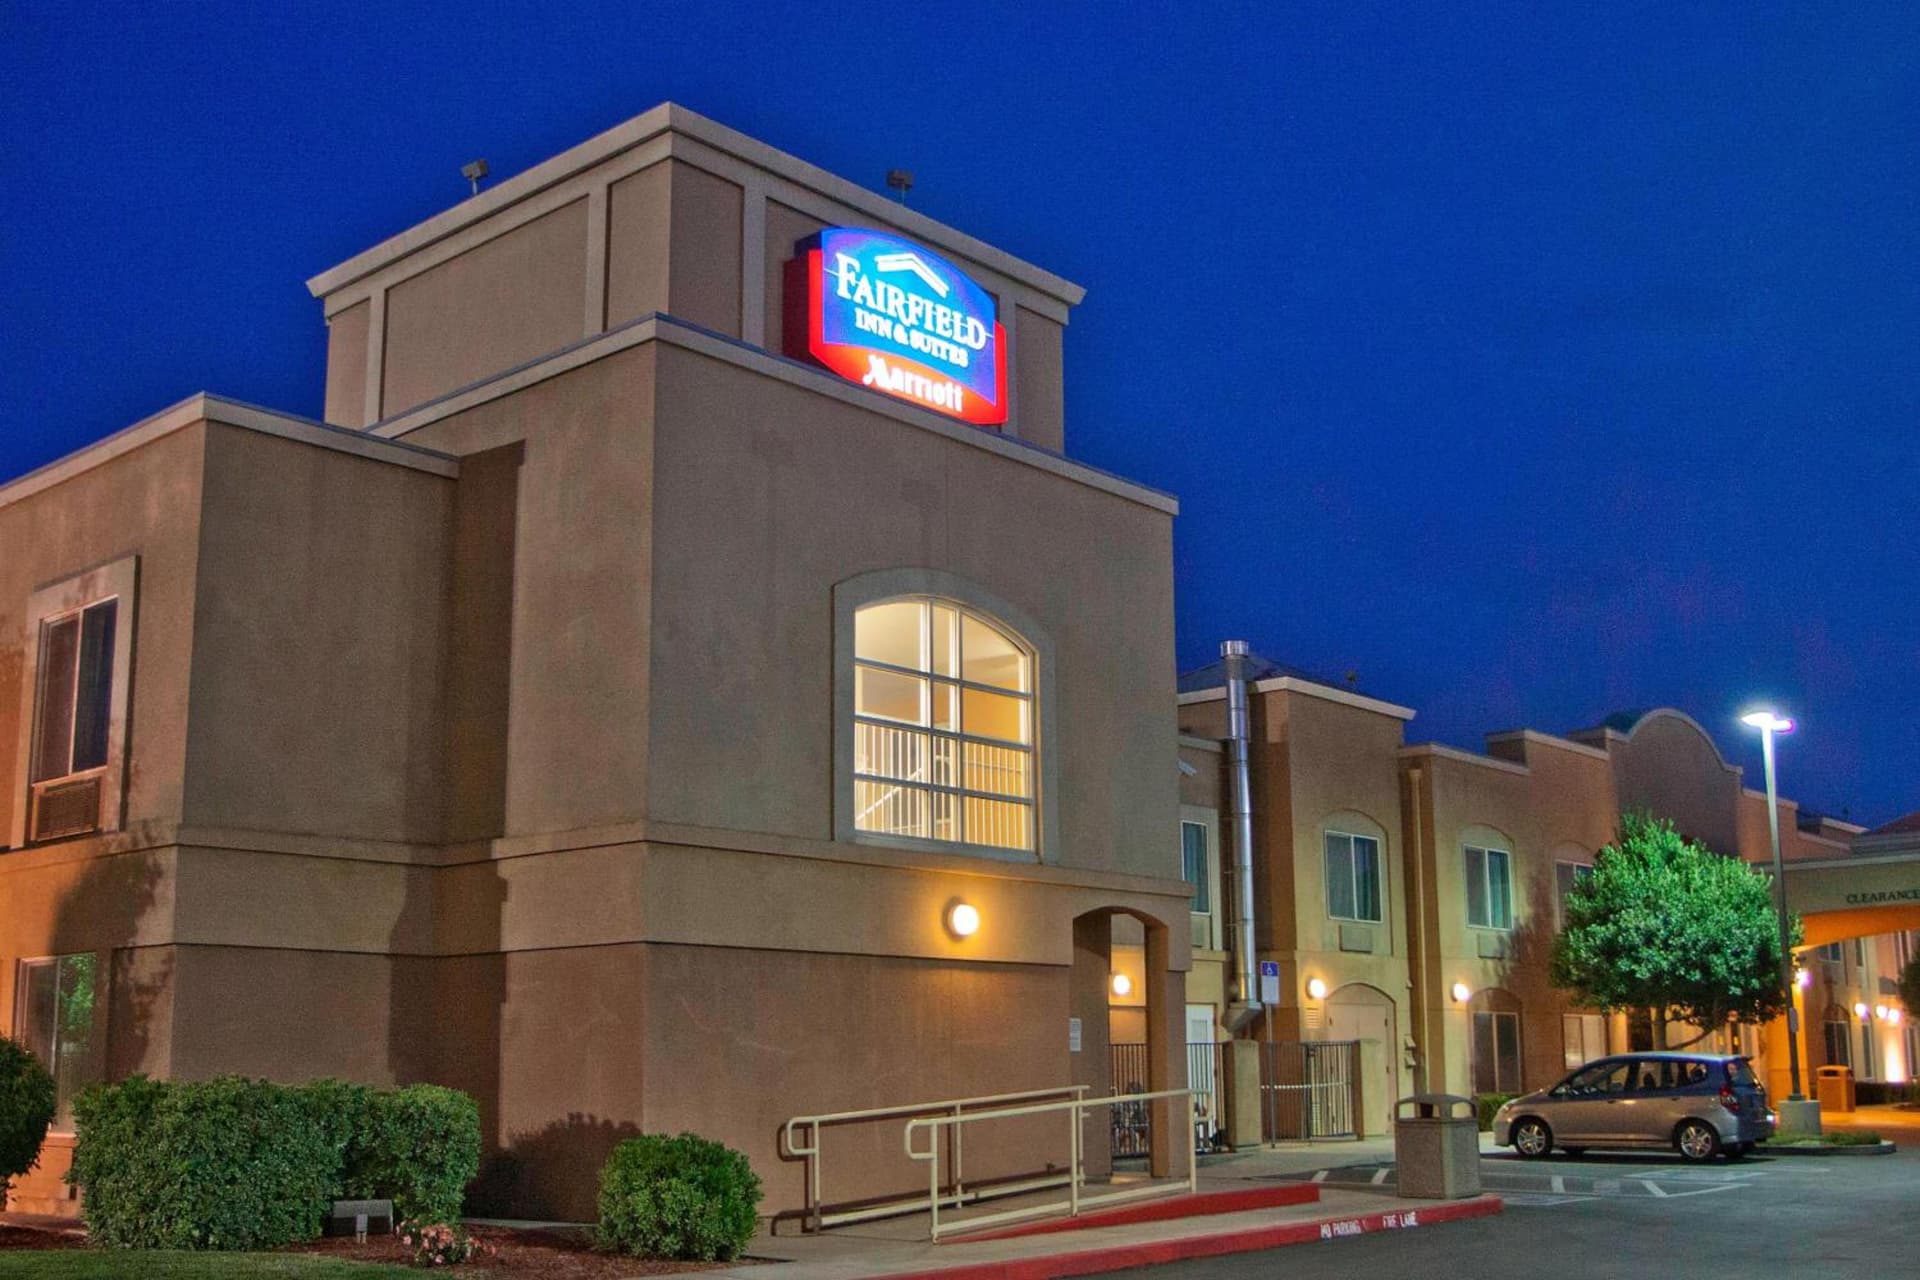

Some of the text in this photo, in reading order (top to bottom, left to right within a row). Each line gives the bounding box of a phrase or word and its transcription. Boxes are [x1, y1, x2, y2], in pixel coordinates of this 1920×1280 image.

[835, 252, 987, 350] FAIRFIELD
[855, 308, 969, 368] INN & SUITES
[862, 355, 964, 412] Marriott
